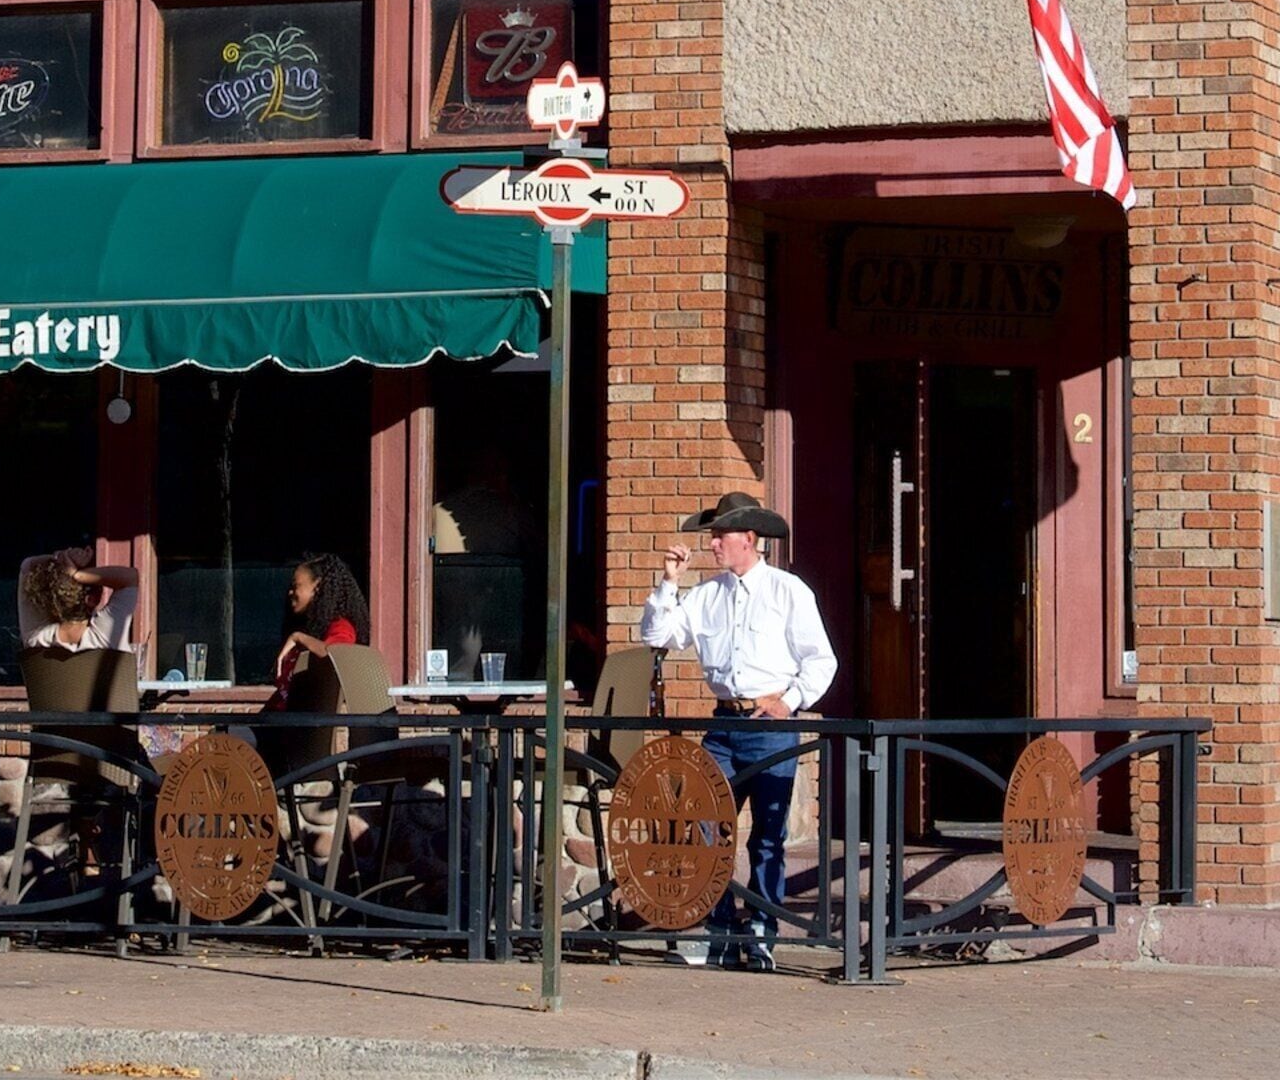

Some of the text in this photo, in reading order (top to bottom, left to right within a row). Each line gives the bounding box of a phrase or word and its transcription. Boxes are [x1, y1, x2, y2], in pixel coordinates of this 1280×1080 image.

[205, 65, 319, 119] Corona
[543, 95, 564, 117] ROUTE
[501, 180, 571, 203] LEROUX
[623, 180, 648, 195] ST
[643, 198, 656, 213] N
[850, 257, 1065, 314] COLLINS
[1073, 413, 1093, 444] 2
[643, 740, 672, 766] PUB
[162, 758, 189, 802] IRISH
[684, 796, 702, 811] 66
[159, 812, 275, 840] COLLINS
[611, 816, 734, 849] COLLINS
[1007, 817, 1086, 845] COLLINS
[656, 882, 690, 900] 1997
